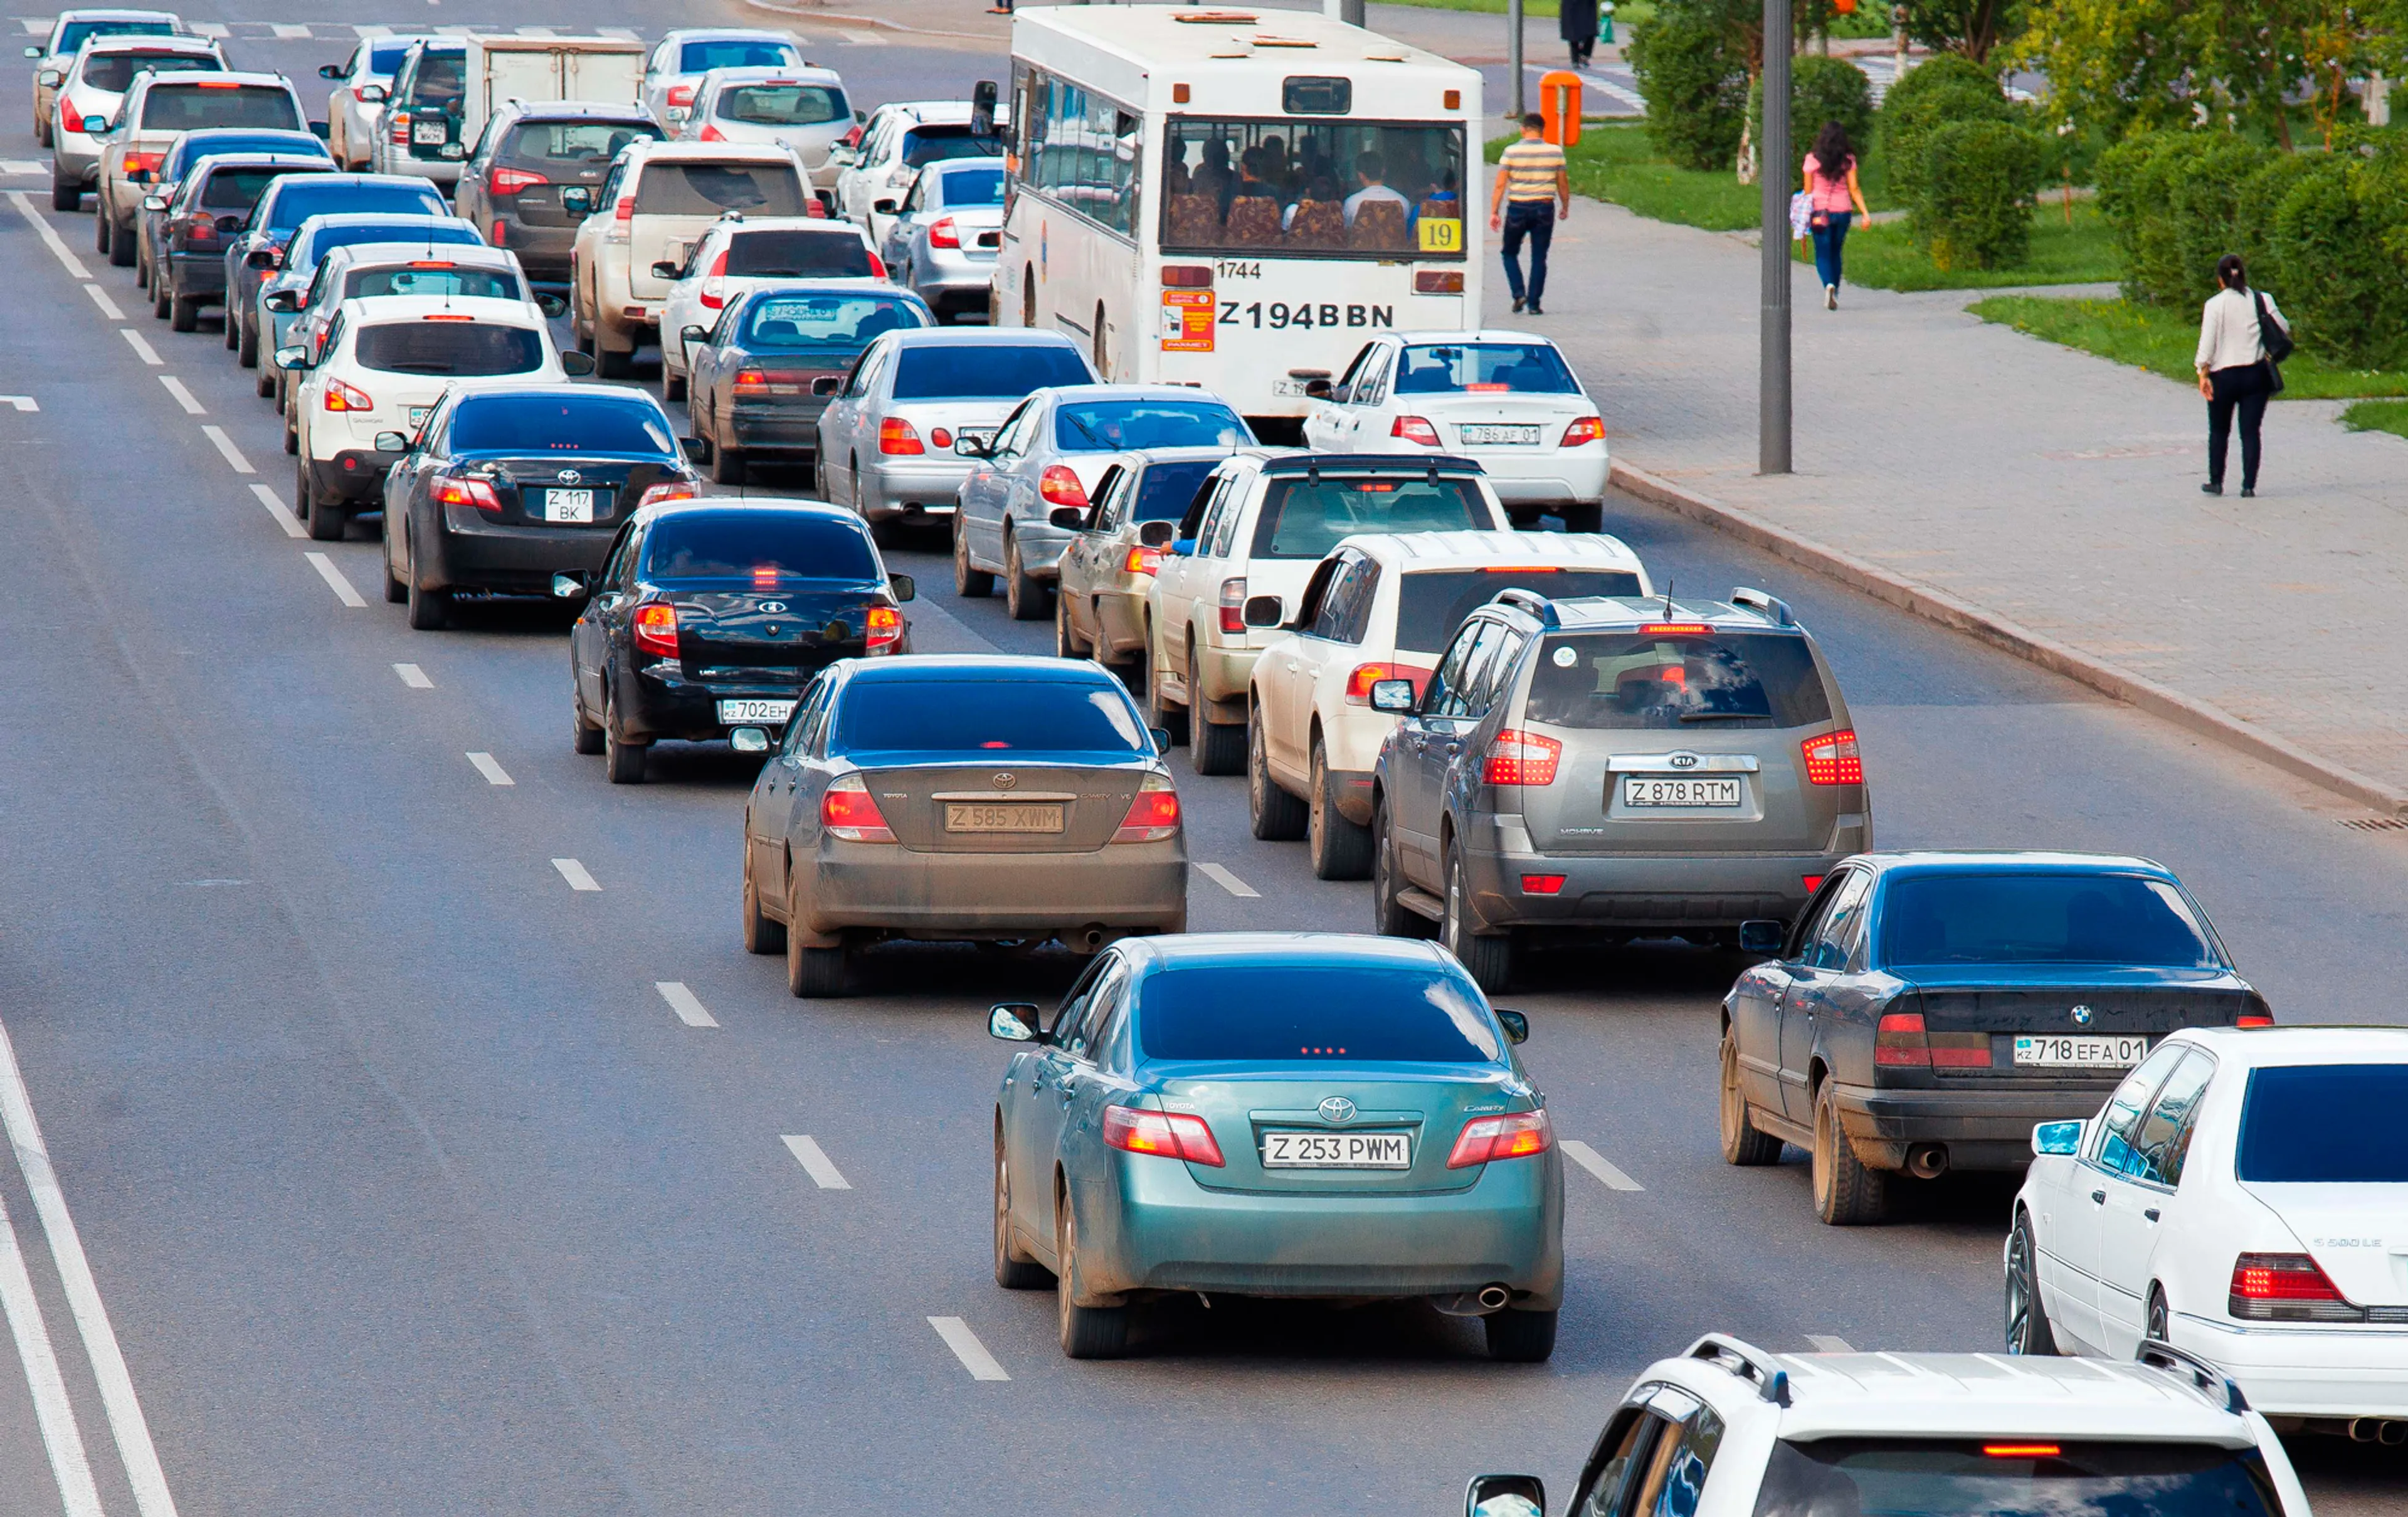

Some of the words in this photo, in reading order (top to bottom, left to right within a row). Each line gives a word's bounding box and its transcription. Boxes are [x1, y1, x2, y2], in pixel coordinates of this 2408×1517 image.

[1427, 223, 1452, 246] 19
[1217, 261, 1262, 279] 1744
[1279, 381, 1287, 394] Z
[1476, 428, 1499, 440] 786
[1523, 428, 1538, 441] 01
[549, 491, 559, 505] Z
[566, 491, 589, 505] 117
[559, 506, 579, 520] BK
[738, 702, 768, 717] 702
[769, 706, 793, 717] EH
[1673, 758, 1694, 766] KIA
[1632, 783, 1645, 800] Z
[1652, 783, 1686, 800] 878
[1693, 783, 1735, 800] RTM
[953, 808, 966, 826] Z
[973, 808, 1007, 827] 585
[1014, 809, 1056, 827] XWM
[2017, 1051, 2032, 1059] KZ
[2036, 1039, 2072, 1060] 718
[2078, 1045, 2113, 1060] EFA
[2120, 1040, 2143, 1060] 01
[1273, 1138, 1289, 1159] Z
[1299, 1138, 1341, 1160] 253
[1349, 1139, 1401, 1160] PWM
[2314, 1238, 2325, 1247] S
